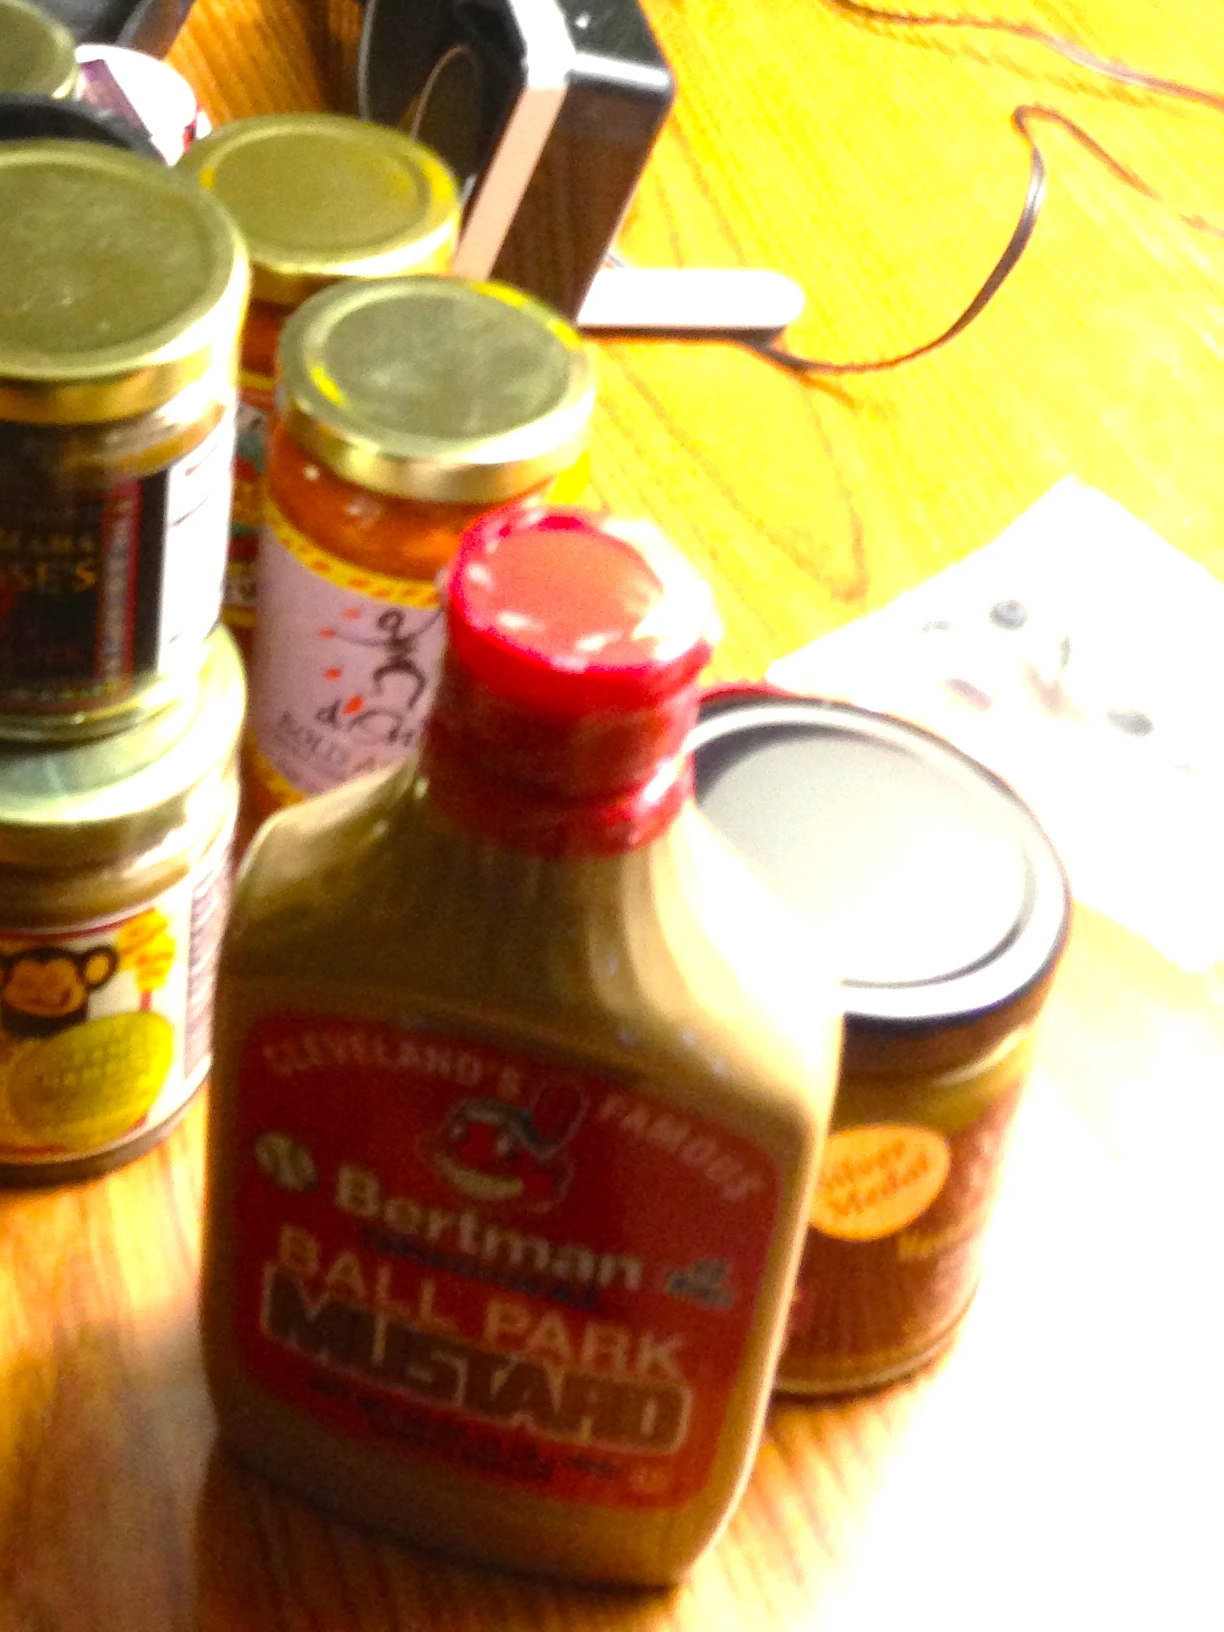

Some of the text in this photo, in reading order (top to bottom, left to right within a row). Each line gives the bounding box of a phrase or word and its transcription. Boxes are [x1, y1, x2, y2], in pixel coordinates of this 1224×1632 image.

[262, 1029, 522, 1102] CLEVELAND'S
[598, 1091, 766, 1205] FAMOUS
[278, 1224, 460, 1336] BALL
[482, 1298, 686, 1382] PARK
